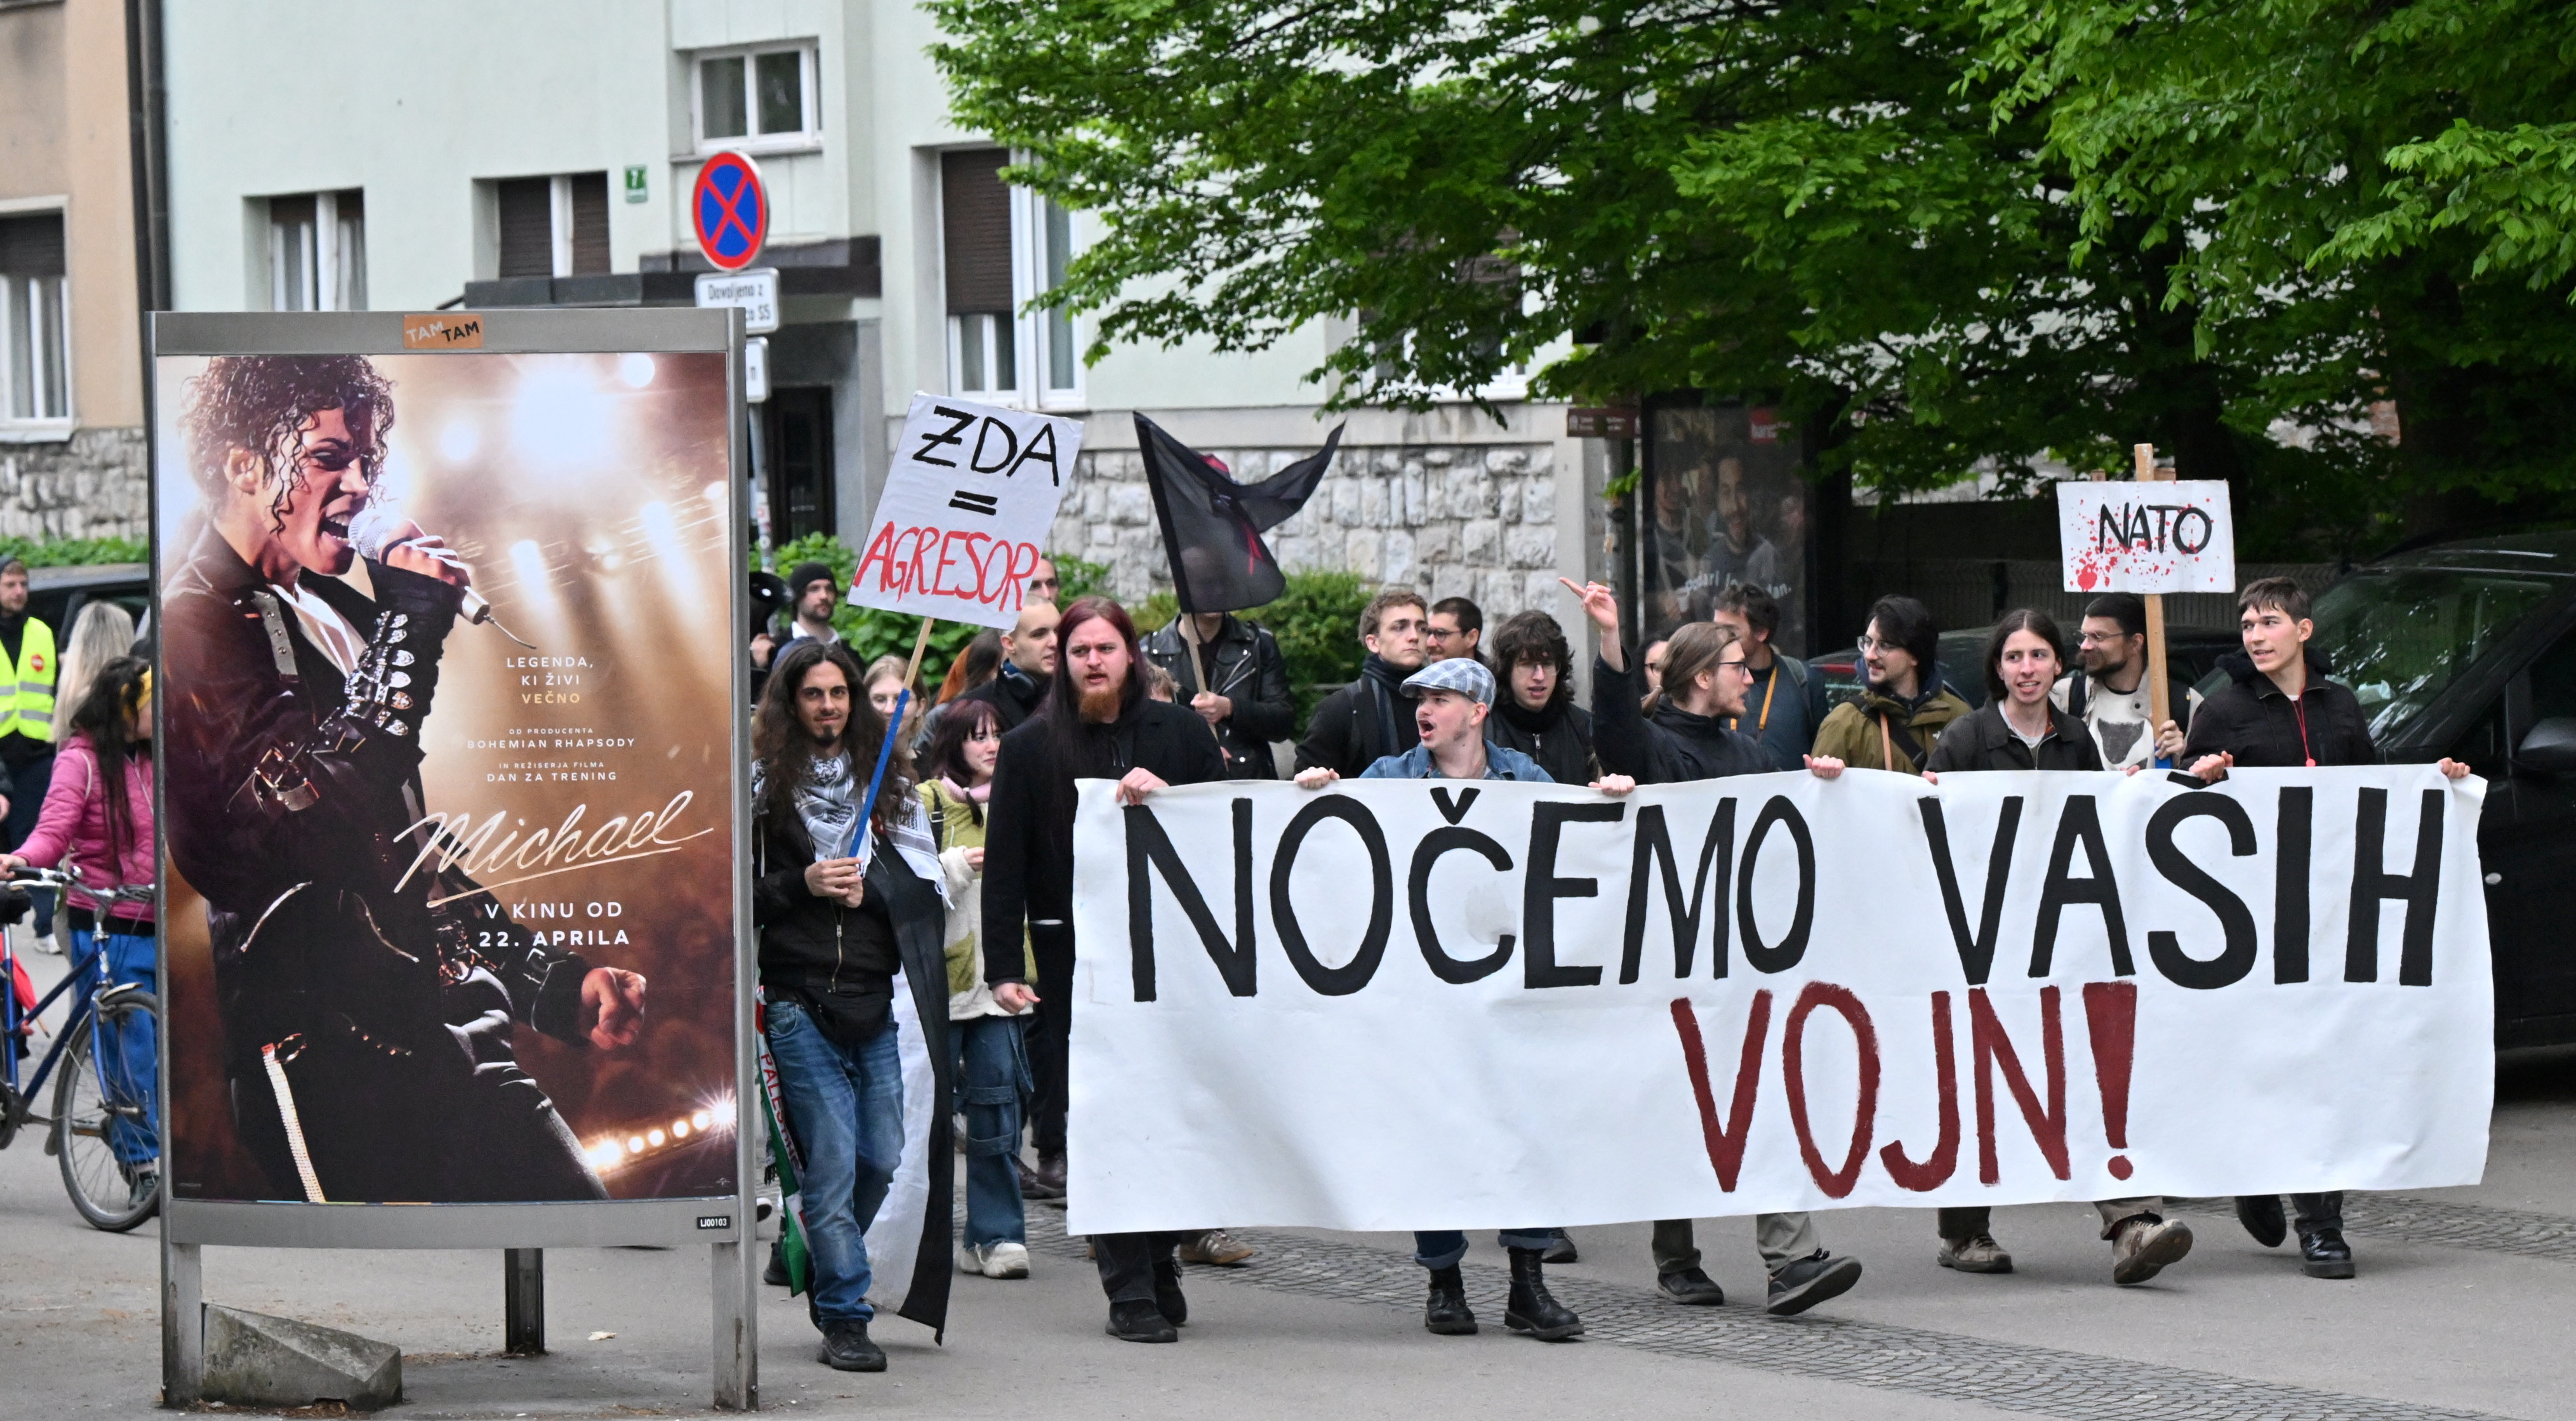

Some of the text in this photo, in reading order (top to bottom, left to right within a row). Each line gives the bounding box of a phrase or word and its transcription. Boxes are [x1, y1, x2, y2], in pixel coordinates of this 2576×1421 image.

[406, 321, 480, 343] TAM TAM
[912, 404, 1059, 487] ZDA
[2099, 501, 2212, 555] NATO
[853, 520, 1040, 612] AGRESOR
[507, 656, 594, 668] LEGENDA,
[521, 672, 580, 686] KI ŽIVI
[521, 690, 581, 704] VEČNO
[467, 737, 635, 750] BOHEMIAN RHAPSODY
[514, 761, 568, 769] REŽISERJA
[486, 771, 618, 782] DAN ZA TRENING
[393, 790, 715, 894] Michael
[1122, 770, 2446, 1003] NOČEMO VAŠIH
[484, 901, 623, 919] V KINU OD
[479, 929, 630, 947] 22. APRILA
[1671, 979, 2138, 1200] VOJN!
[700, 1217, 727, 1228] LJ00103
